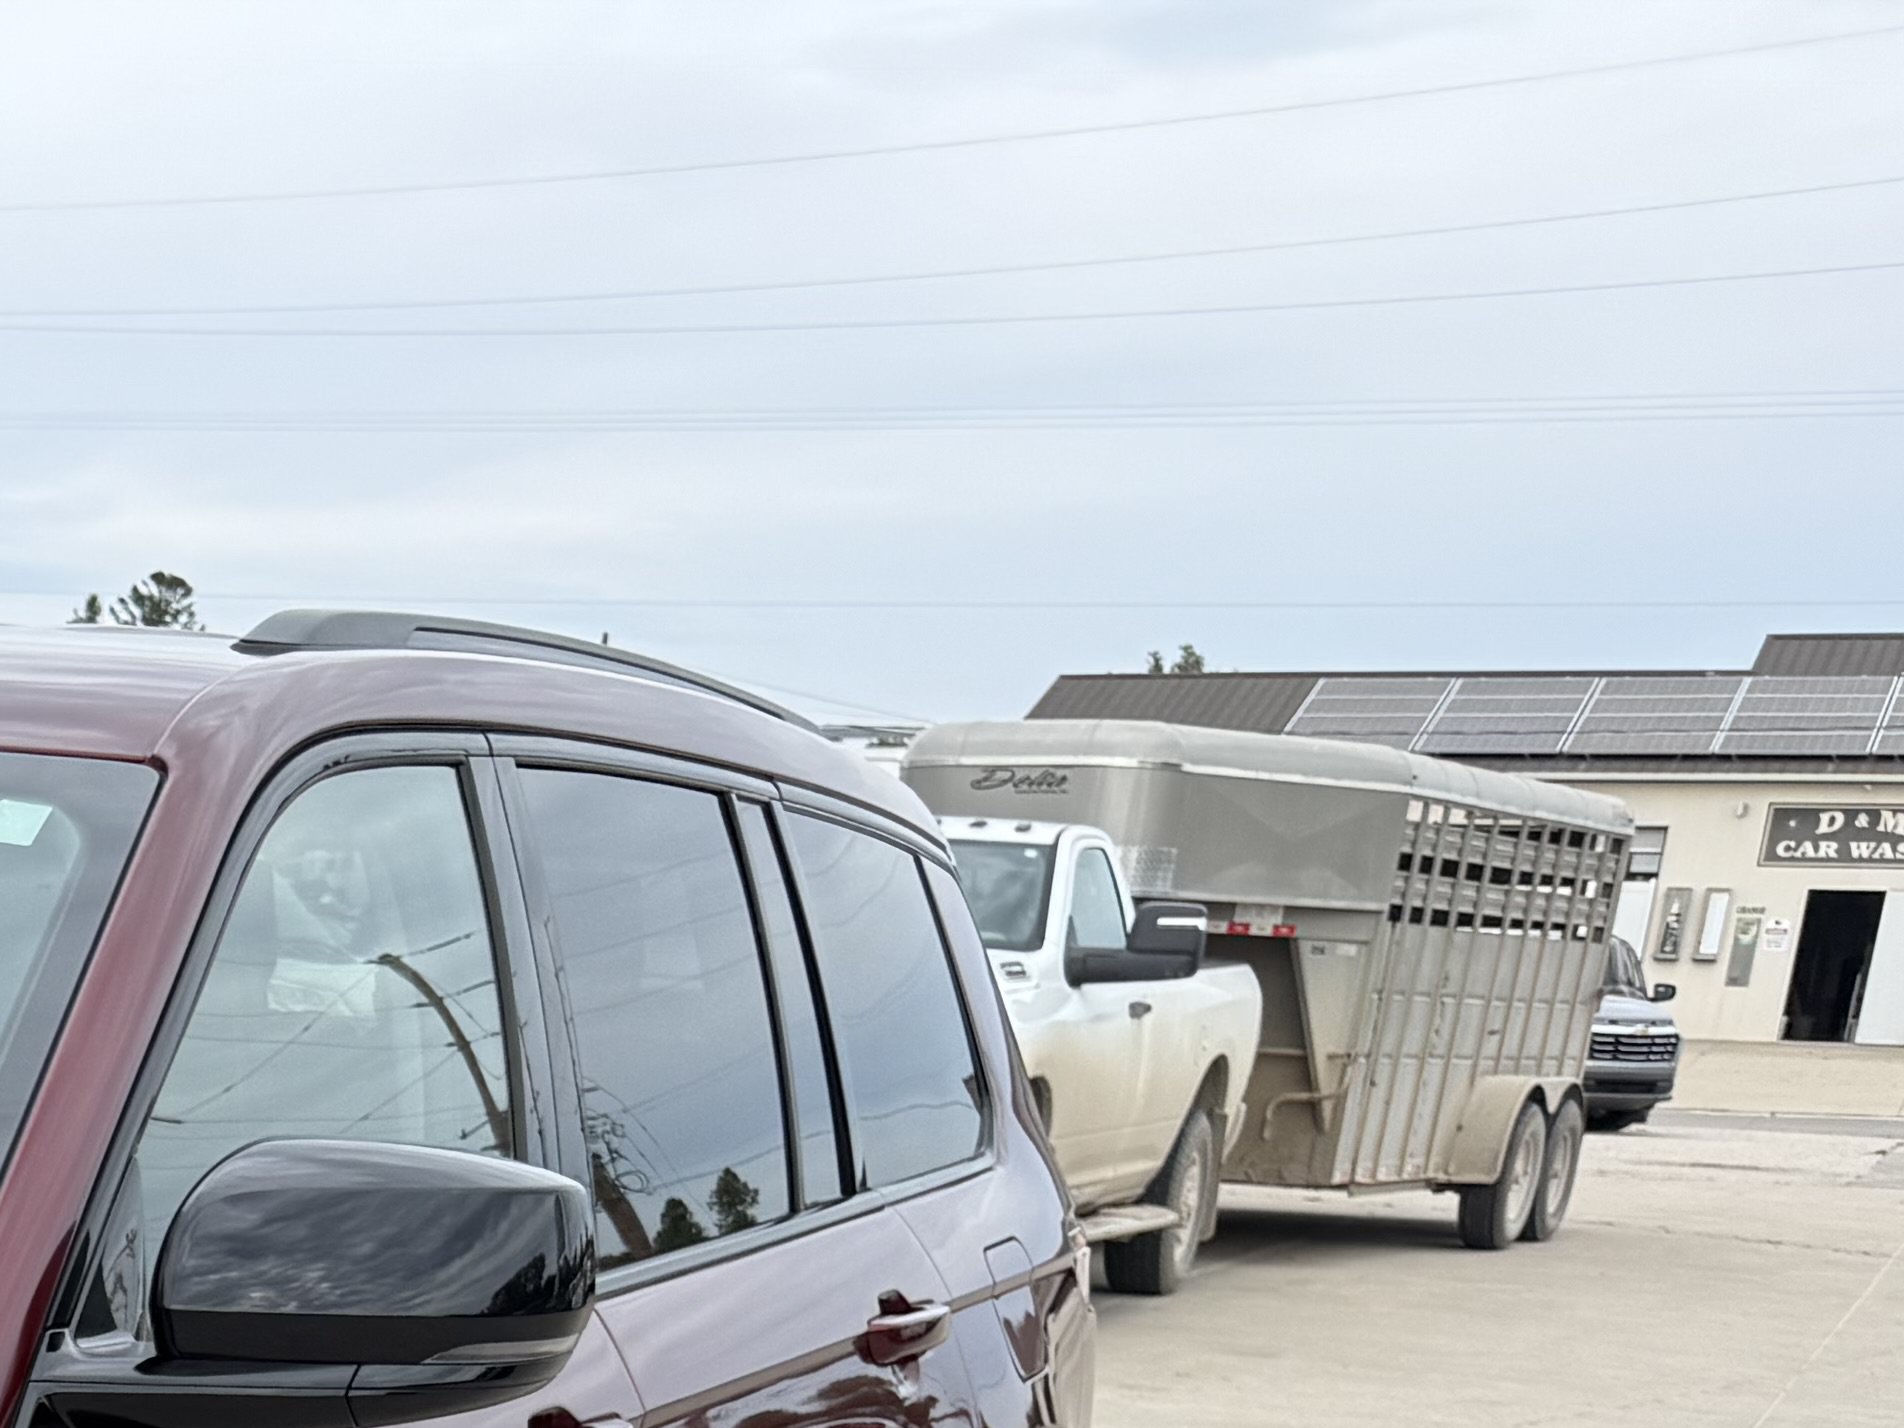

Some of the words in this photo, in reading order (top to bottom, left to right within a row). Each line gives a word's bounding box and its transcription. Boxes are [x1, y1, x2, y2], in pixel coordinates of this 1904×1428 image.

[1815, 810, 1845, 835] D
[1854, 811, 1870, 828] &
[1775, 840, 1839, 858] CAR
